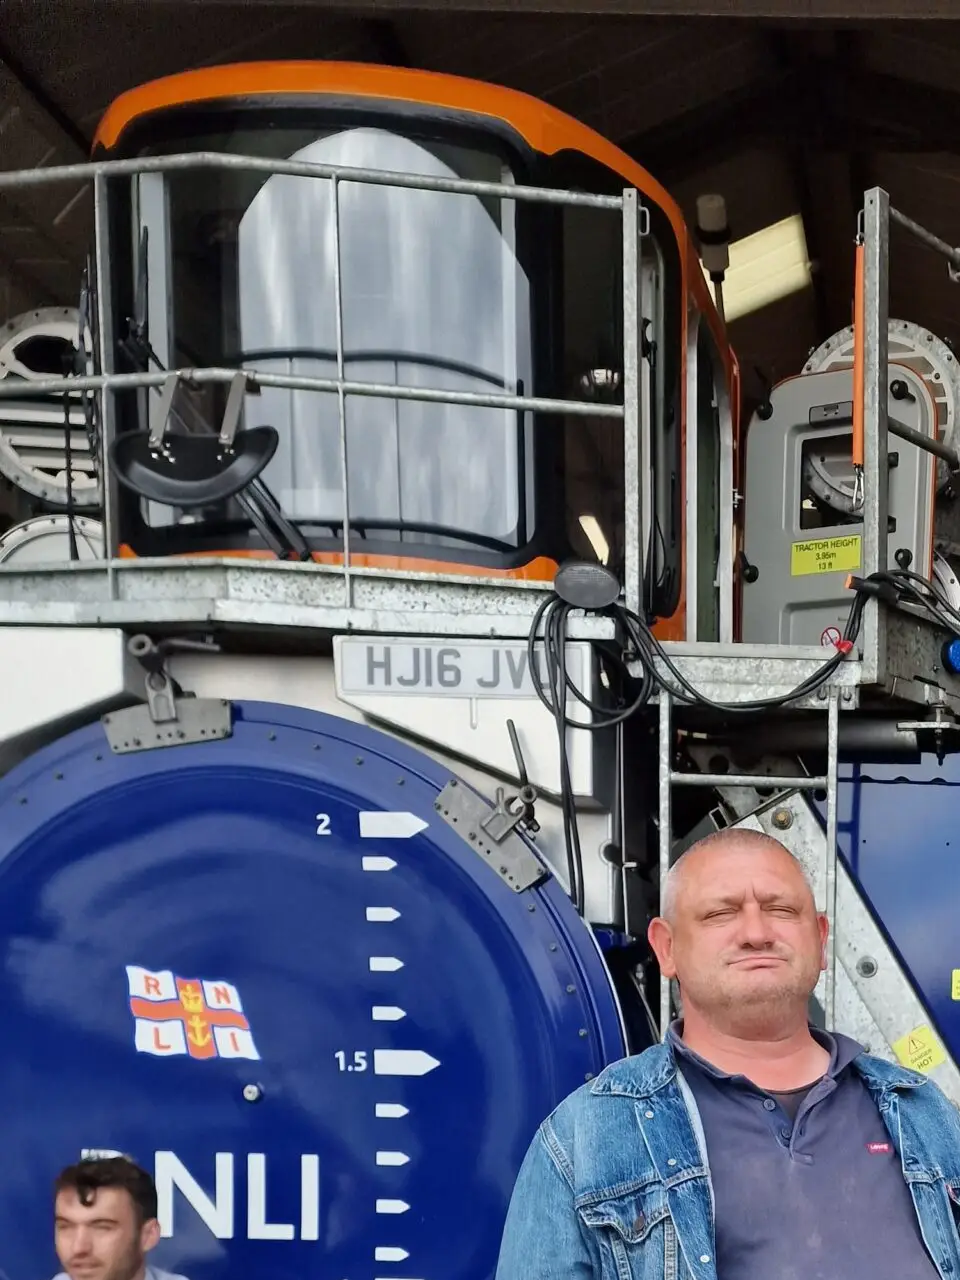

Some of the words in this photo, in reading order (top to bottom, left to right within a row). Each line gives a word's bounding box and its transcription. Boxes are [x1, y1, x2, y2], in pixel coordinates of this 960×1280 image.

[795, 541, 828, 553] TRACTOR
[831, 538, 858, 548] HEIGHT
[366, 646, 461, 688] HJ16
[316, 813, 332, 835] 2
[335, 1050, 367, 1072] 1.5
[917, 1056, 933, 1069] HOT
[81, 1149, 319, 1240] NLI
